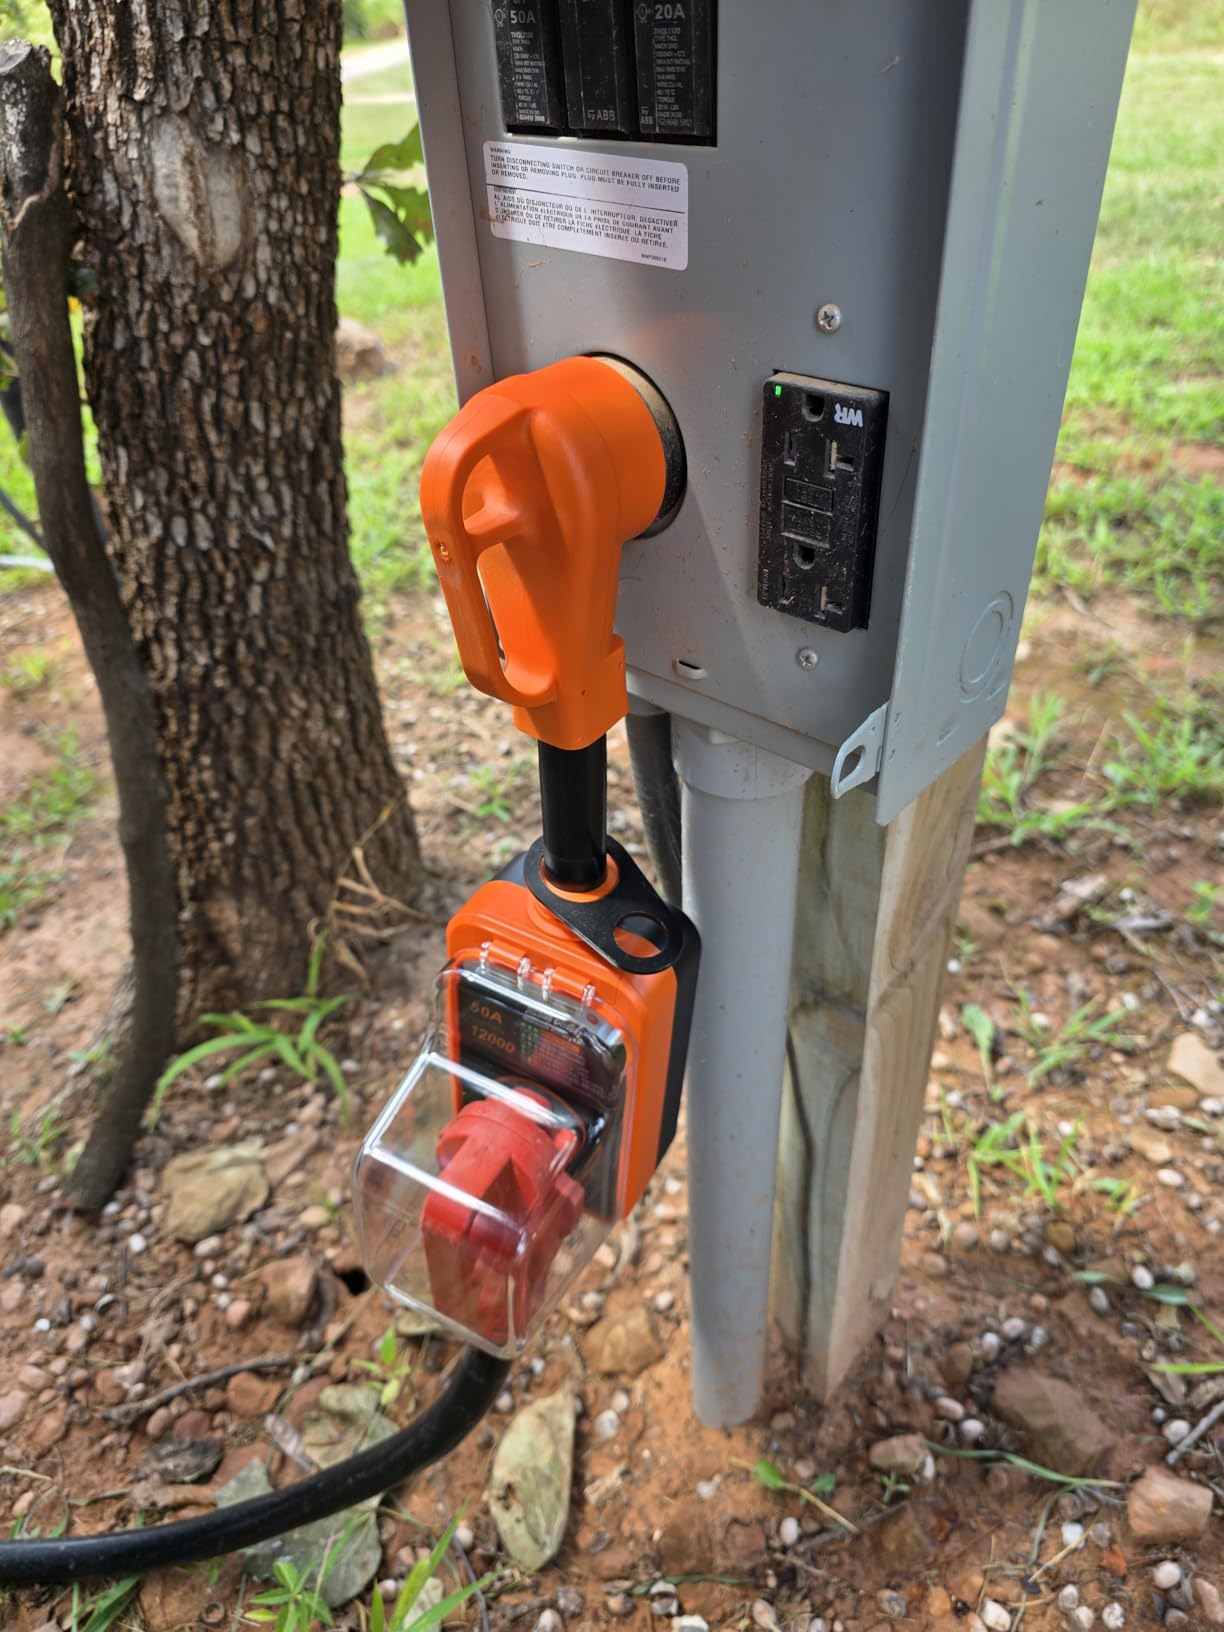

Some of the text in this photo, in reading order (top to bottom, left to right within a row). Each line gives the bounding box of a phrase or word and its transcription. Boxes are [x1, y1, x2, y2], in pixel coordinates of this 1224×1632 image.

[510, 9, 536, 24] 50A
[655, 4, 686, 19] 20A
[597, 109, 616, 122] ABB
[490, 155, 505, 163] TURN
[507, 157, 550, 168] DISCONNECTING
[552, 162, 574, 172] SWITCH
[586, 167, 609, 176] CIRCUIT
[611, 170, 640, 180] BREAKER
[641, 174, 653, 182] OFF
[655, 175, 681, 185] BEFORE
[491, 162, 519, 171] INSERTING
[530, 167, 560, 177] REMOVING
[580, 174, 596, 182] PLUG
[597, 176, 615, 184] MUST
[616, 178, 625, 186] BE
[626, 180, 646, 189] FULLY
[647, 182, 680, 193] INSERTED
[576, 220, 593, 230] FICHE
[643, 231, 662, 240] FICHE
[622, 220, 651, 231] COURANT
[652, 225, 673, 234] AVANT
[630, 236, 640, 244] OU
[834, 402, 864, 428] WR
[470, 1001, 503, 1025] 50A
